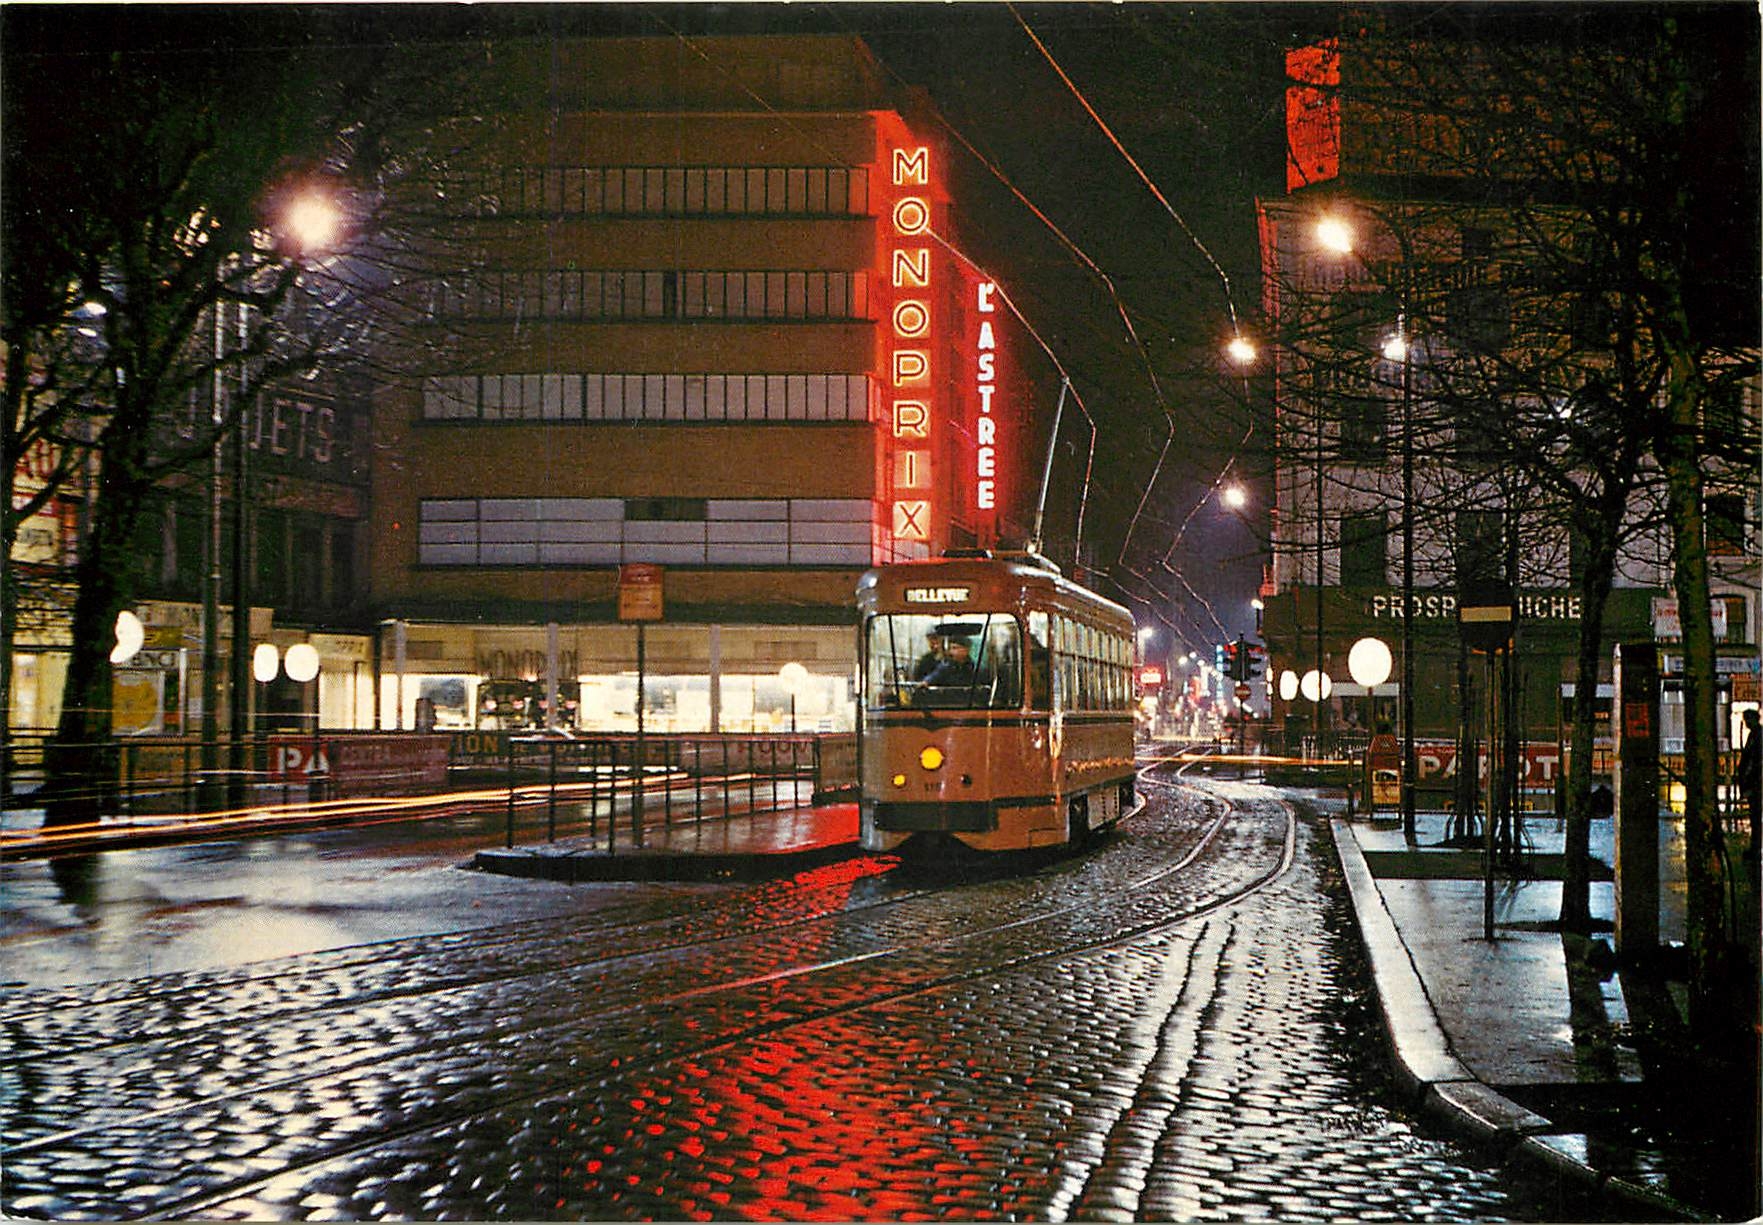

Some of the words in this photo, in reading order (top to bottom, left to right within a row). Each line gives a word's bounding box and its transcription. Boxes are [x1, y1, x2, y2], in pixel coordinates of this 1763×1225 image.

[891, 146, 932, 539] MONOPRIX
[976, 282, 997, 510] L'ASTREE
[906, 588, 970, 603] BELLEVUE
